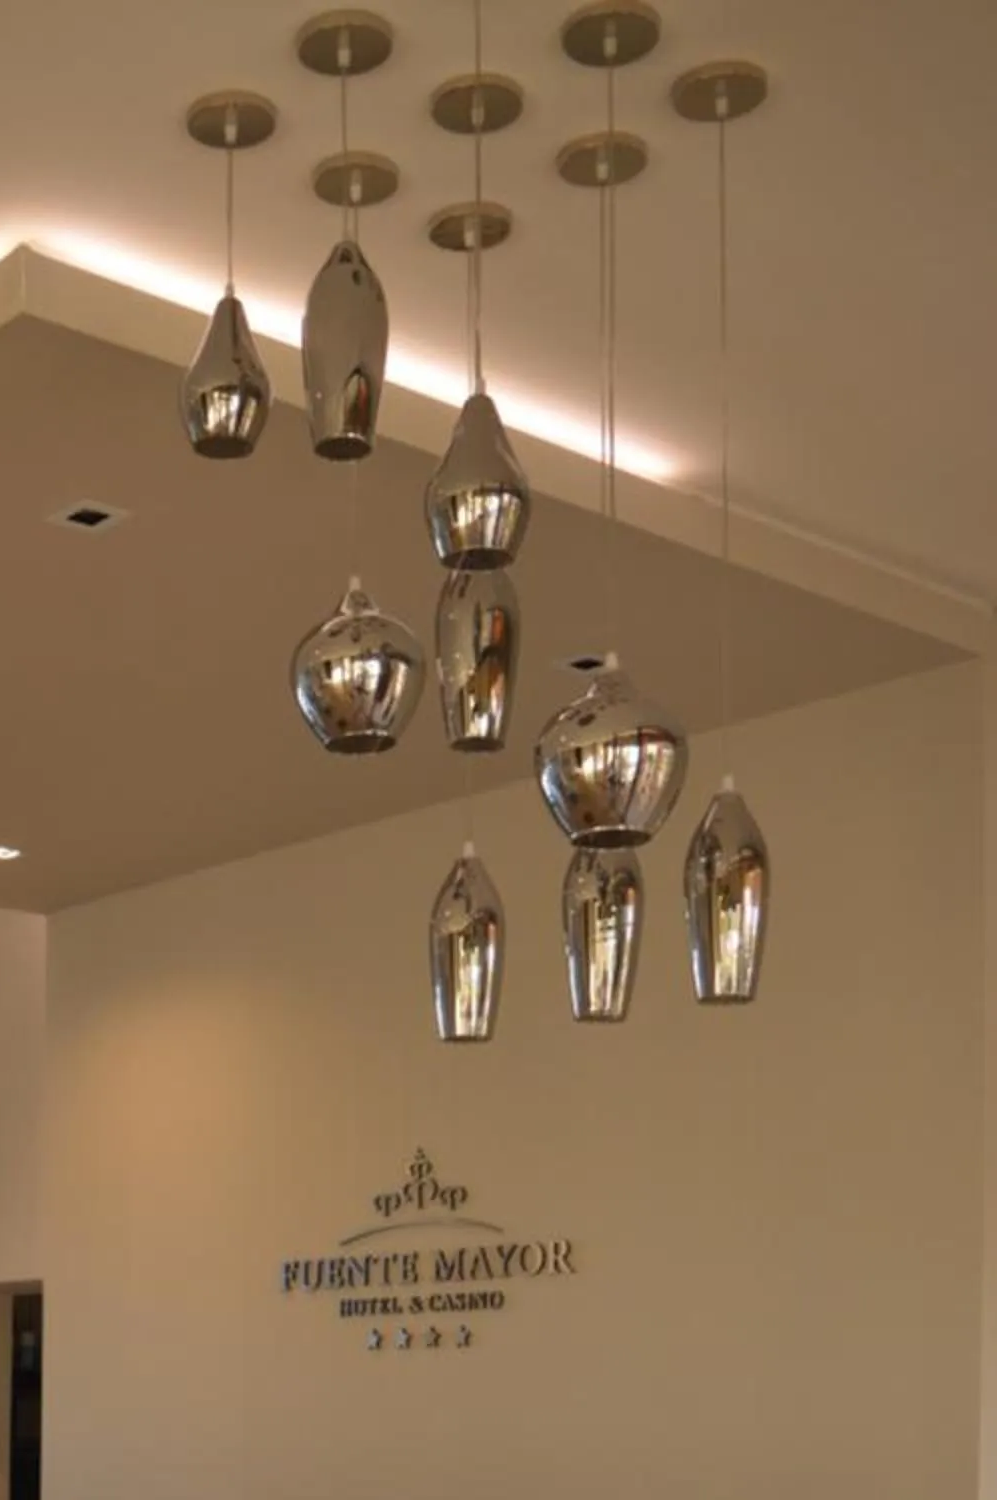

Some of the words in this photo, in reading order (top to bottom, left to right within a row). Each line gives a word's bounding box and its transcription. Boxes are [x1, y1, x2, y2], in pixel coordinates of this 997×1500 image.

[282, 1251, 420, 1292] FUENTE
[433, 1239, 576, 1283] MAYOR
[339, 1296, 403, 1318] HOTEL
[409, 1295, 424, 1315] &
[426, 1290, 506, 1313] CASINO
